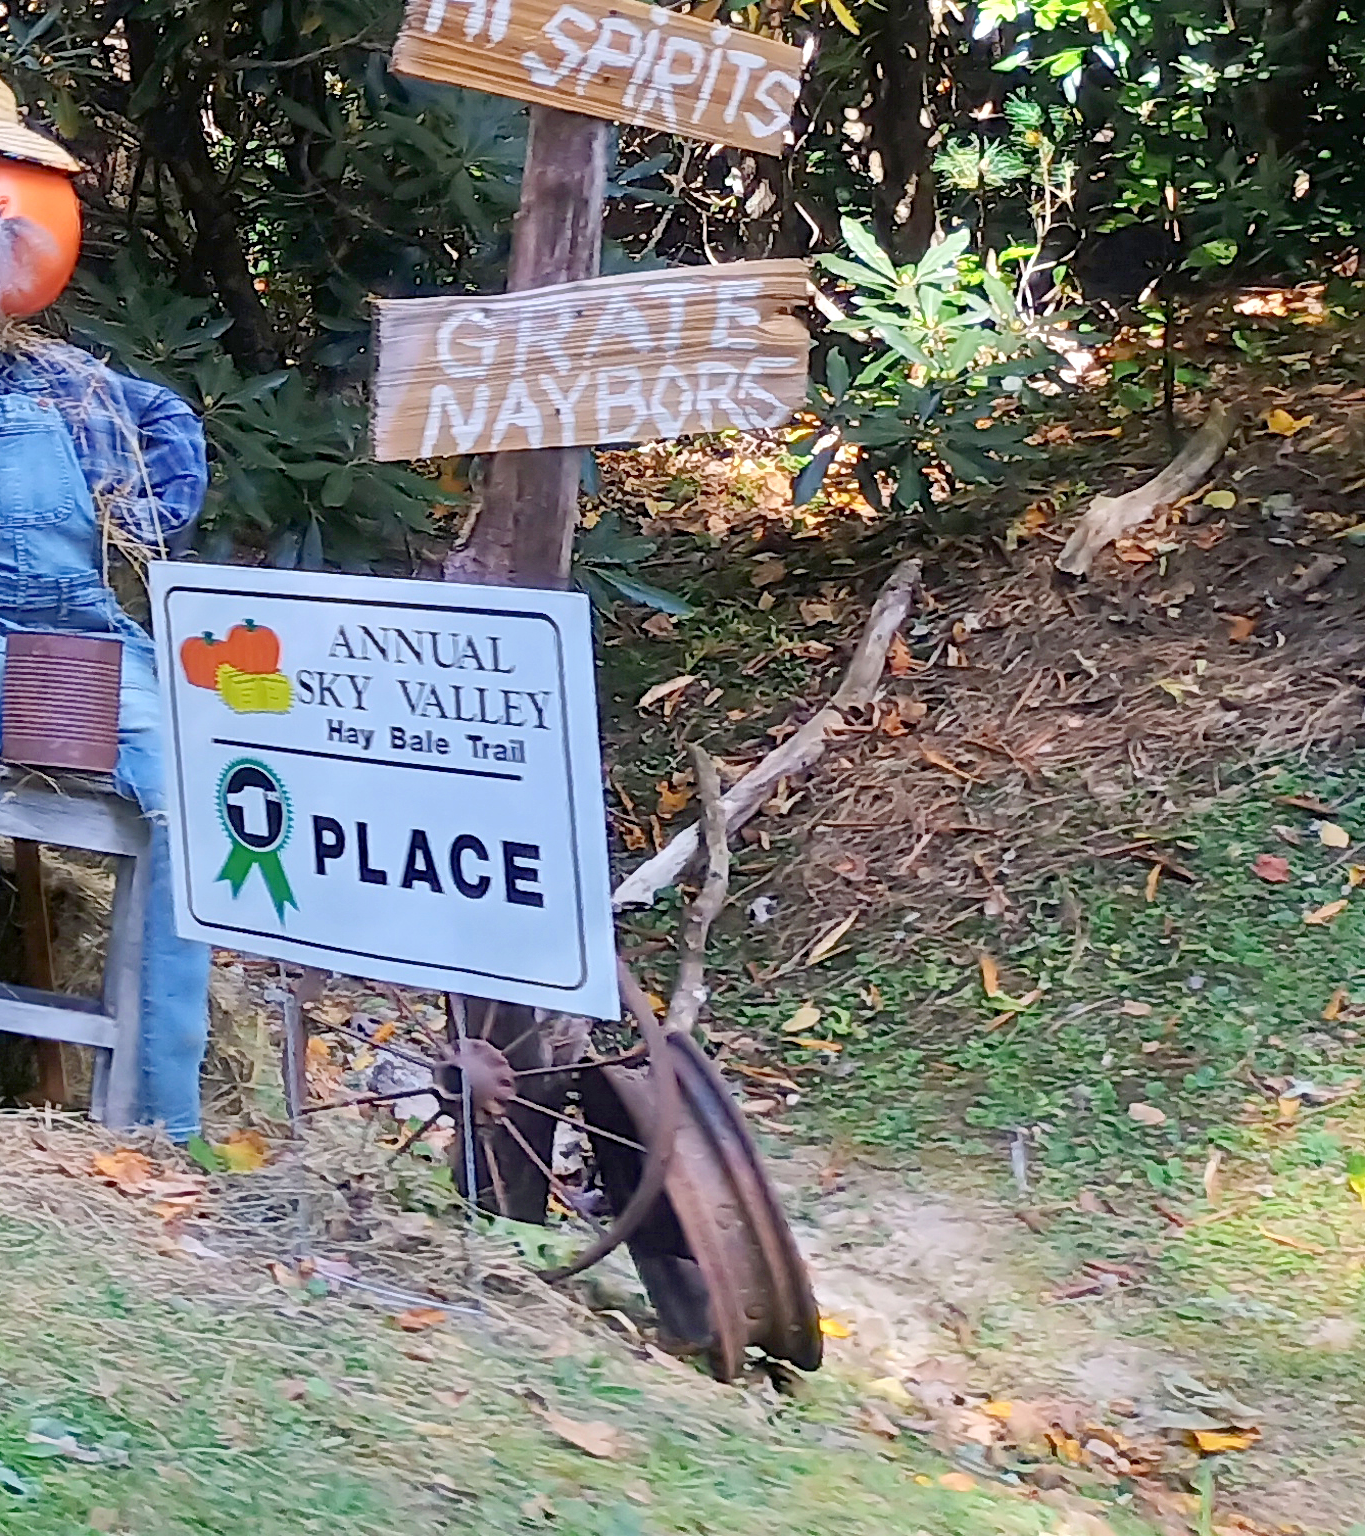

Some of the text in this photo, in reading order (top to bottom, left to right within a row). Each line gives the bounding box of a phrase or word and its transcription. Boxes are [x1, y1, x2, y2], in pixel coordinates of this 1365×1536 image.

[435, 280, 764, 380] GRATE
[420, 357, 800, 458] NAYBORS
[329, 624, 515, 675] ANNUAL
[296, 669, 553, 731] SKY VALLEY
[327, 719, 525, 764] Hay Bale Trail
[312, 814, 545, 909] PLACE
